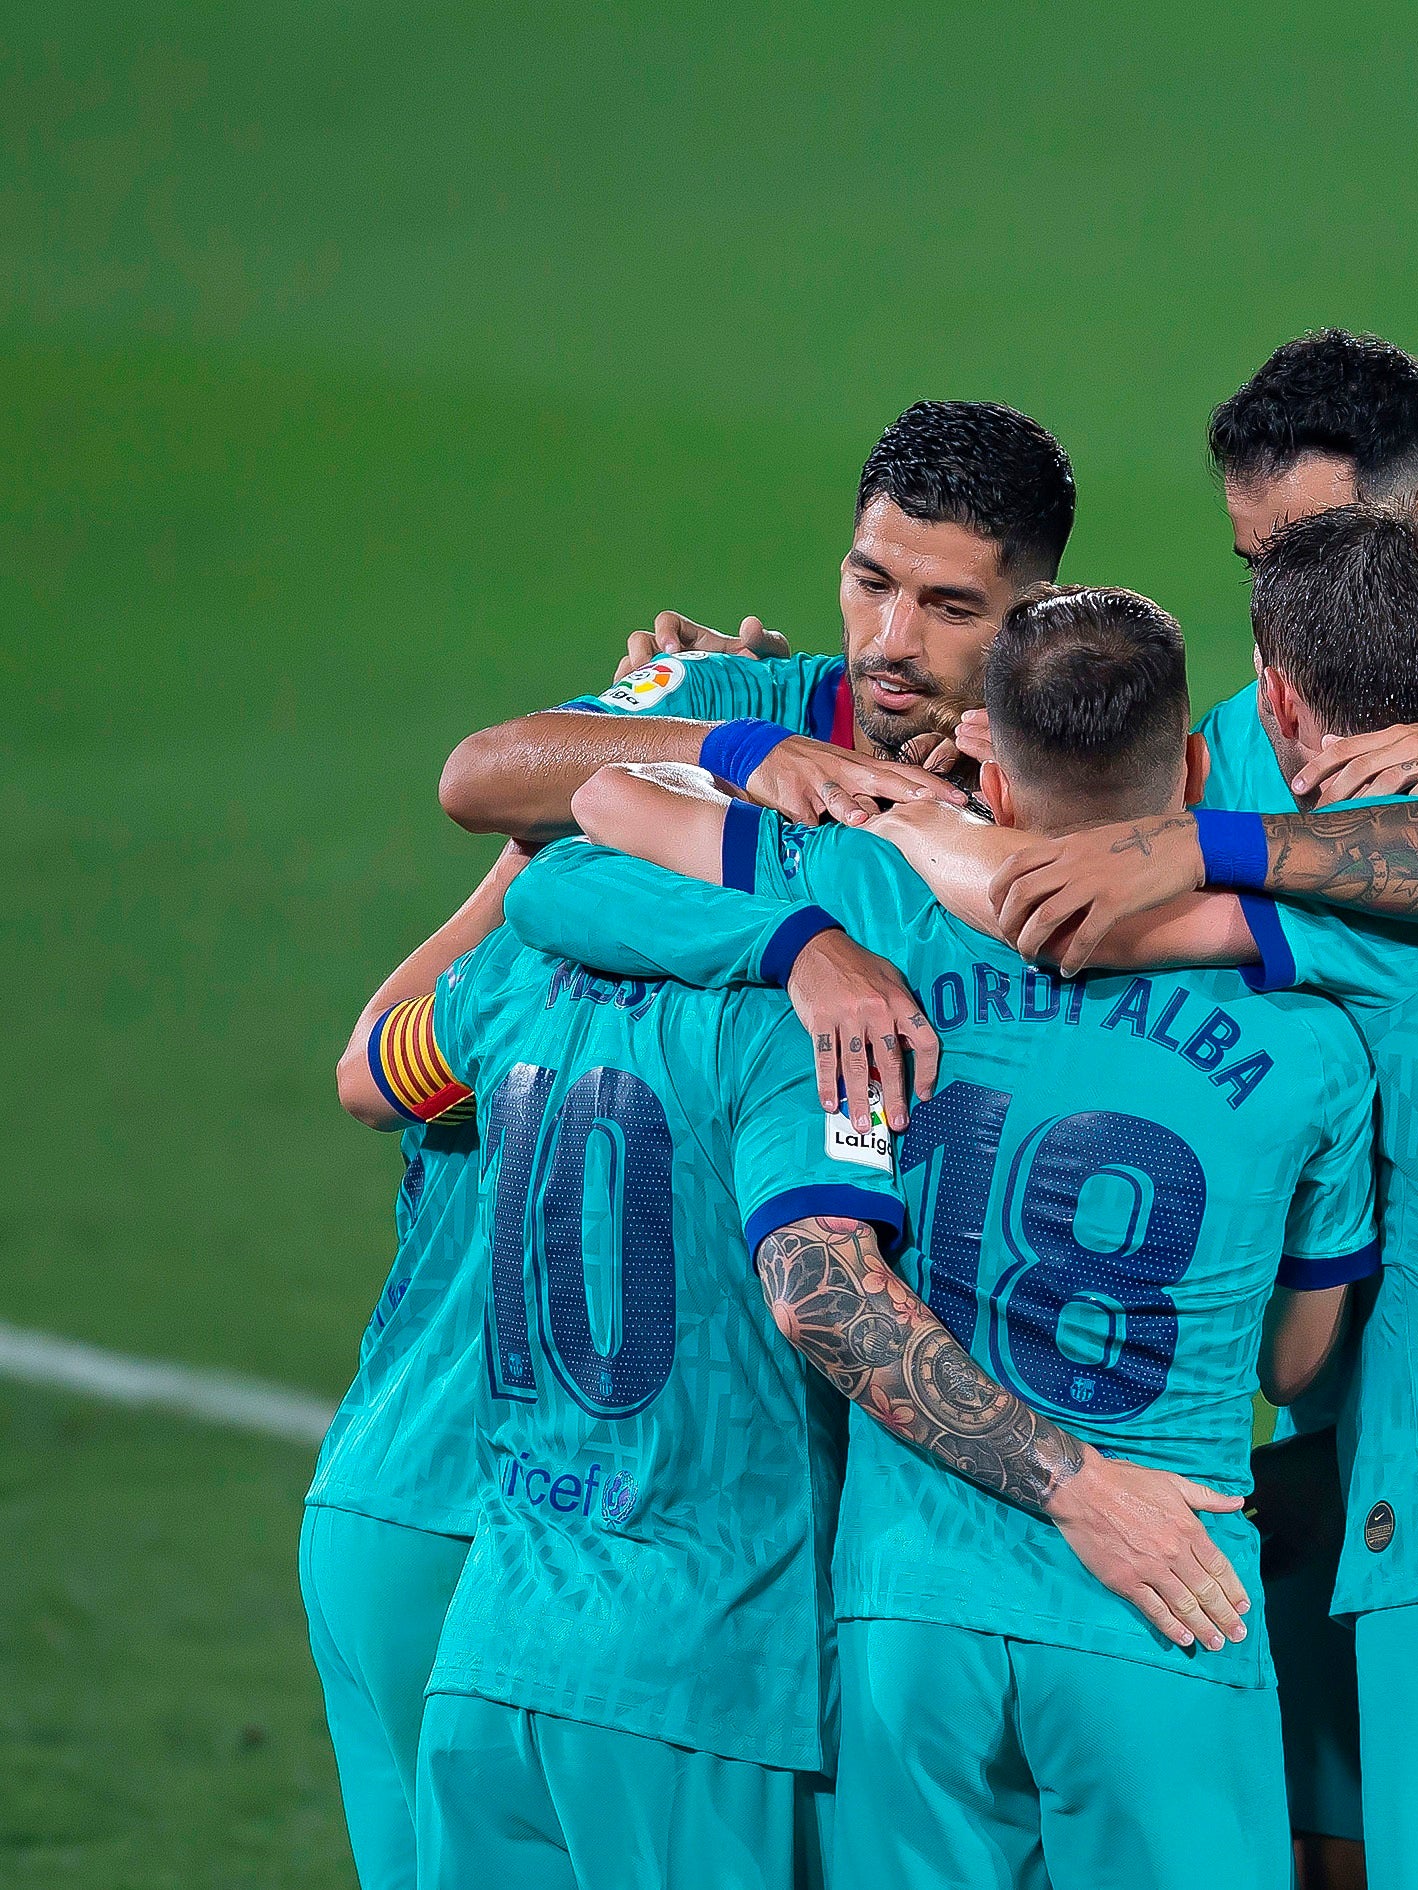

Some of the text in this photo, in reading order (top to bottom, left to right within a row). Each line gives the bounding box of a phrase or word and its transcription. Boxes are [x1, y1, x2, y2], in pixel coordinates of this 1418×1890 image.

[914, 961, 1275, 1112] ORDI ALBA
[477, 1063, 678, 1422] 10
[899, 1078, 1209, 1425] 18
